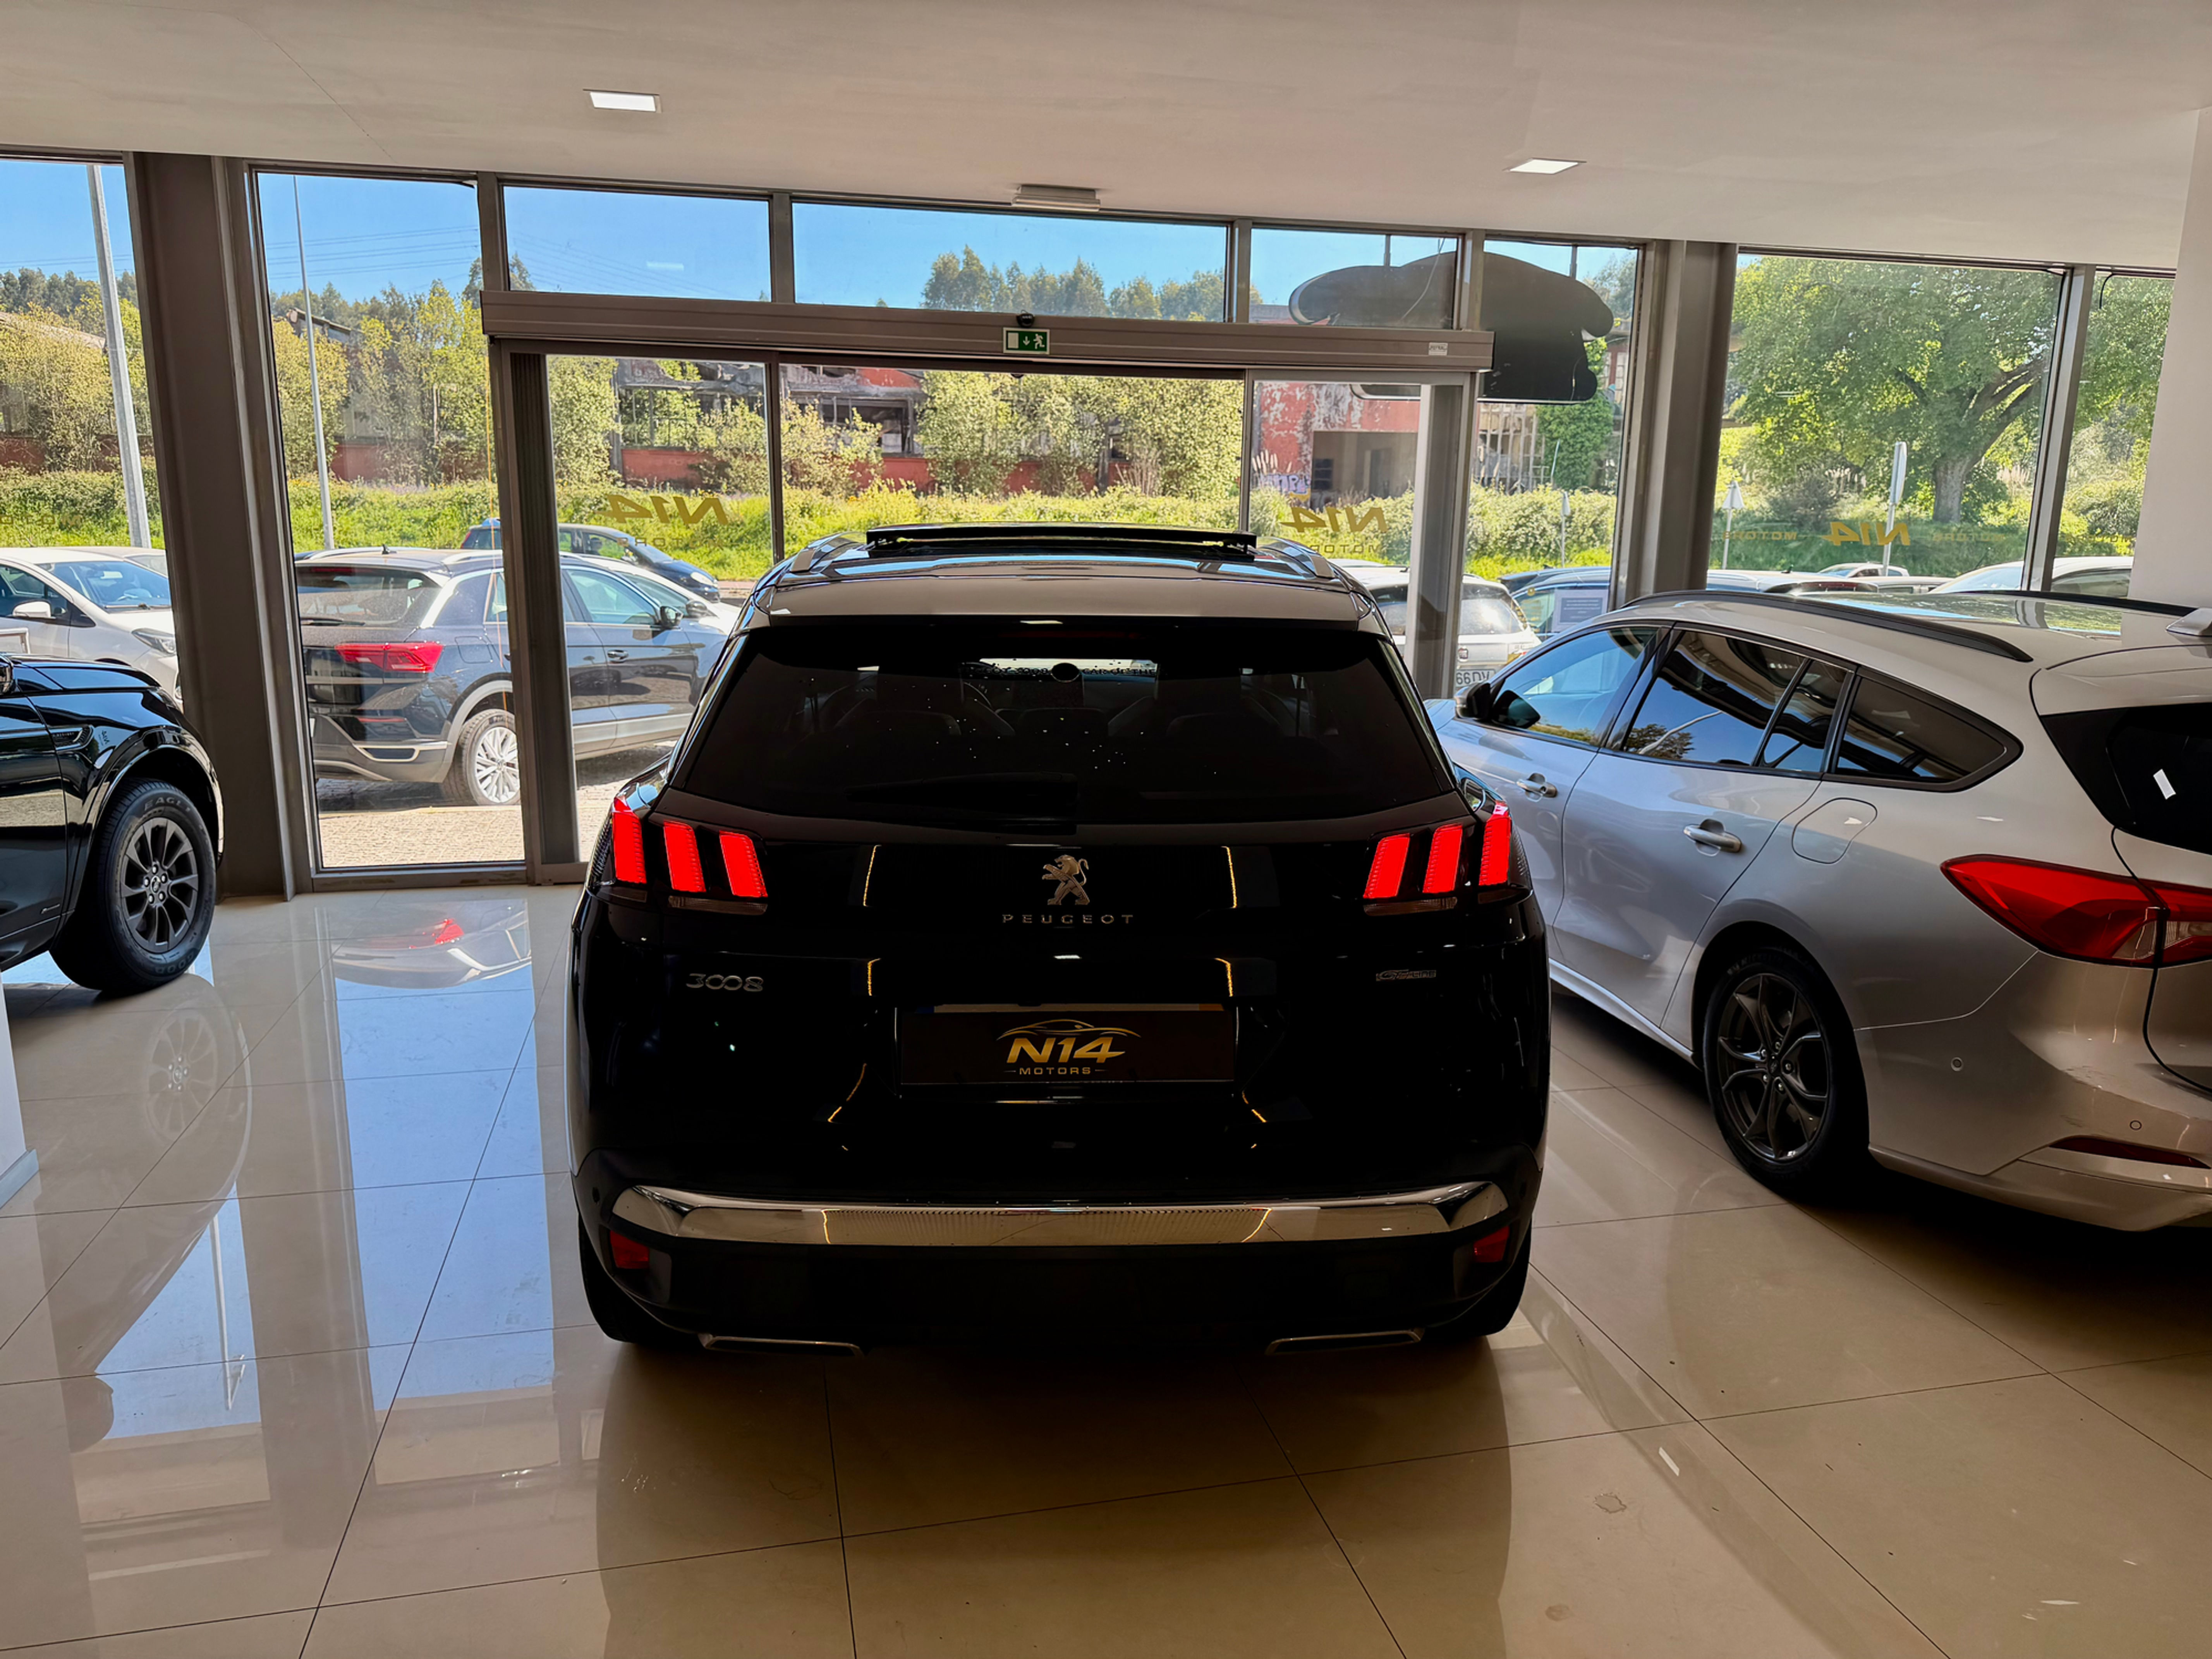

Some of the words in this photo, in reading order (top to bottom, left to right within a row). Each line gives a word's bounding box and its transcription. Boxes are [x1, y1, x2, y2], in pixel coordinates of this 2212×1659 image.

[1002, 914, 1133, 924] PEUGEOT
[686, 973, 764, 992] 3008
[1007, 1037, 1125, 1063] N14
[1019, 1067, 1091, 1075] MOTORS
